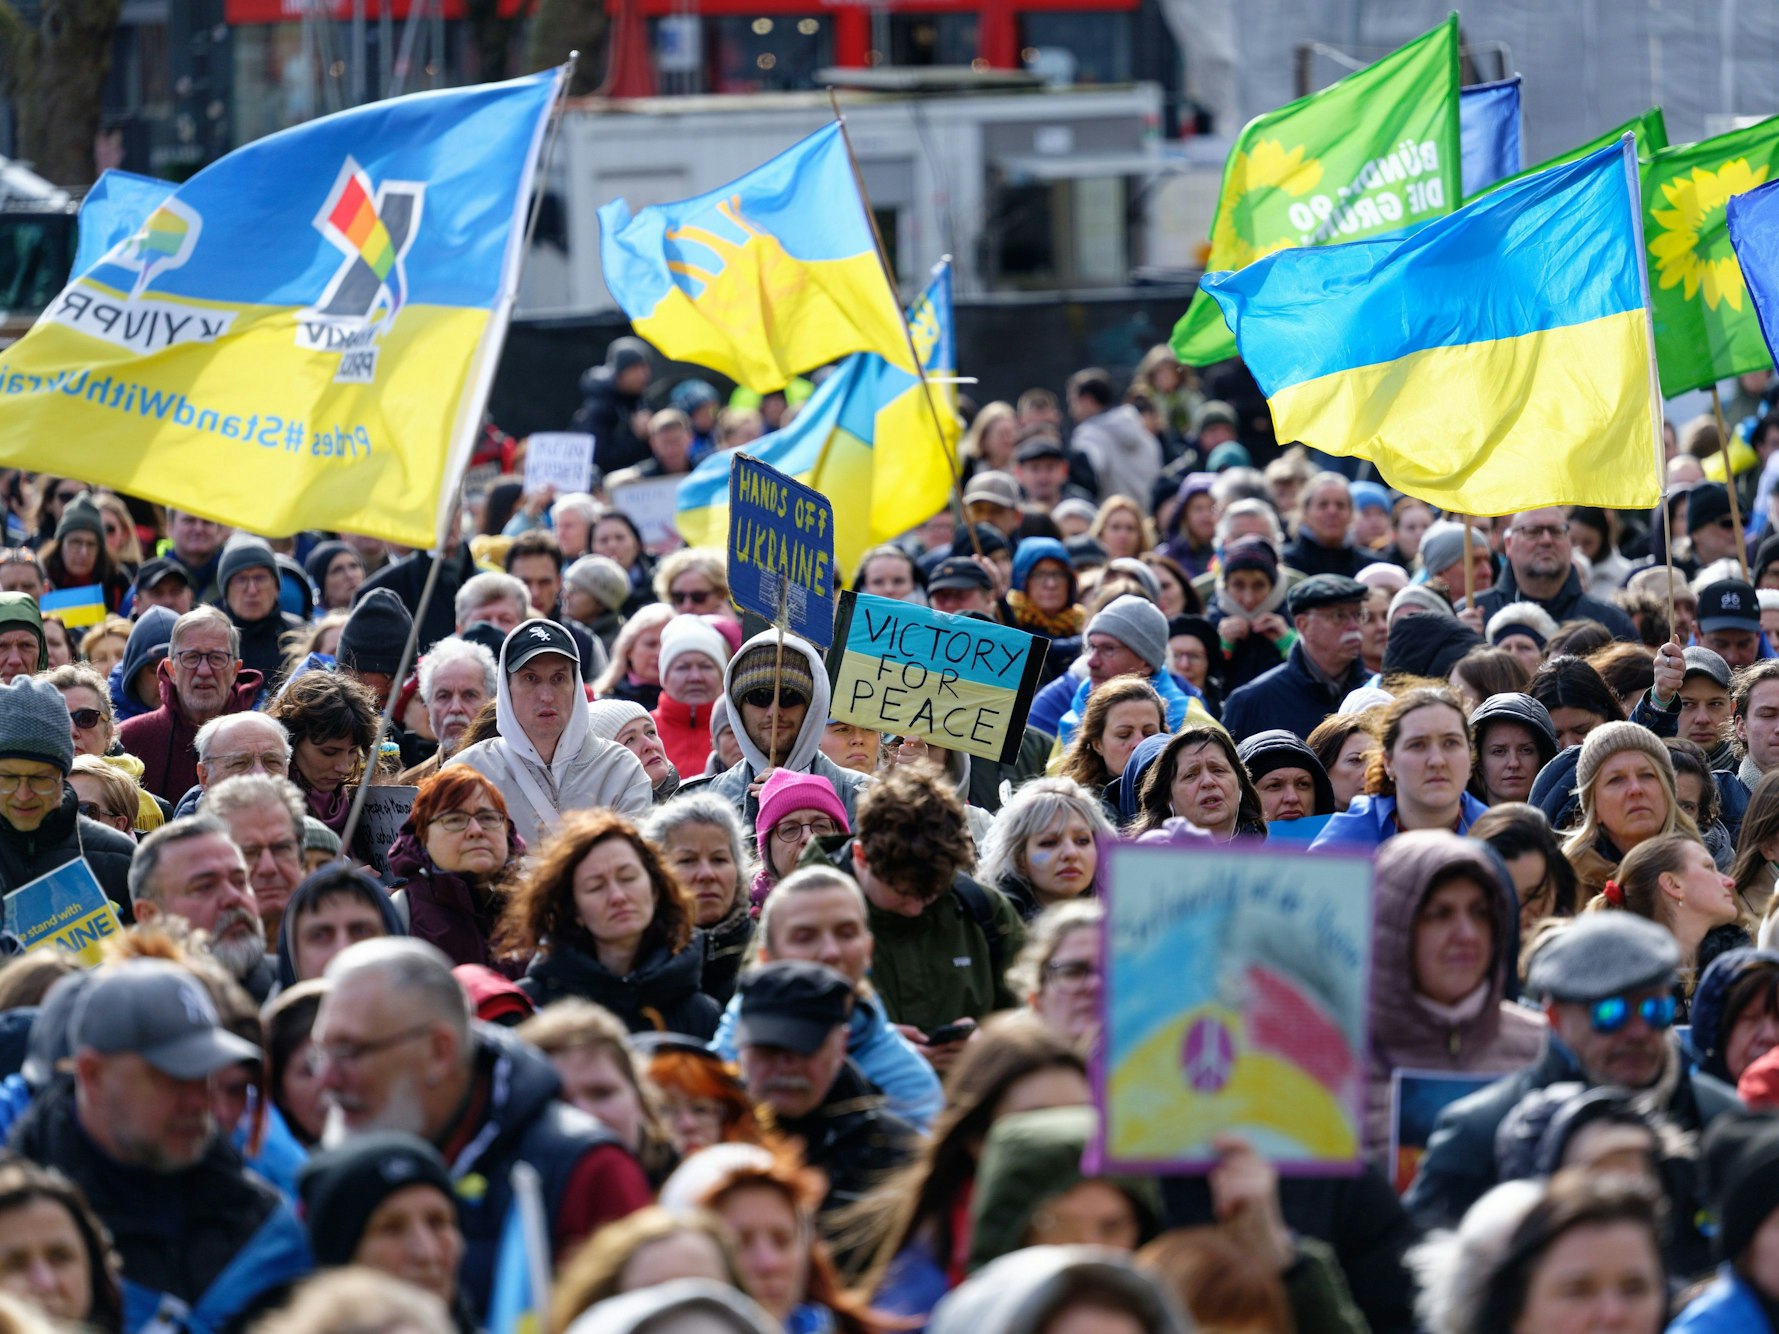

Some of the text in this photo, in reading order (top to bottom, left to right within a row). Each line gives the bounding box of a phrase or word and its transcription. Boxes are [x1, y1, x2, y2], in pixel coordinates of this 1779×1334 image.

[739, 464, 828, 538] HANDS OFF
[737, 516, 829, 597] UKRAINE
[865, 609, 1024, 677] VICTORY
[877, 654, 959, 699] FOR
[850, 679, 1000, 745] PEACE
[28, 915, 58, 938] stand
[57, 902, 83, 921] with
